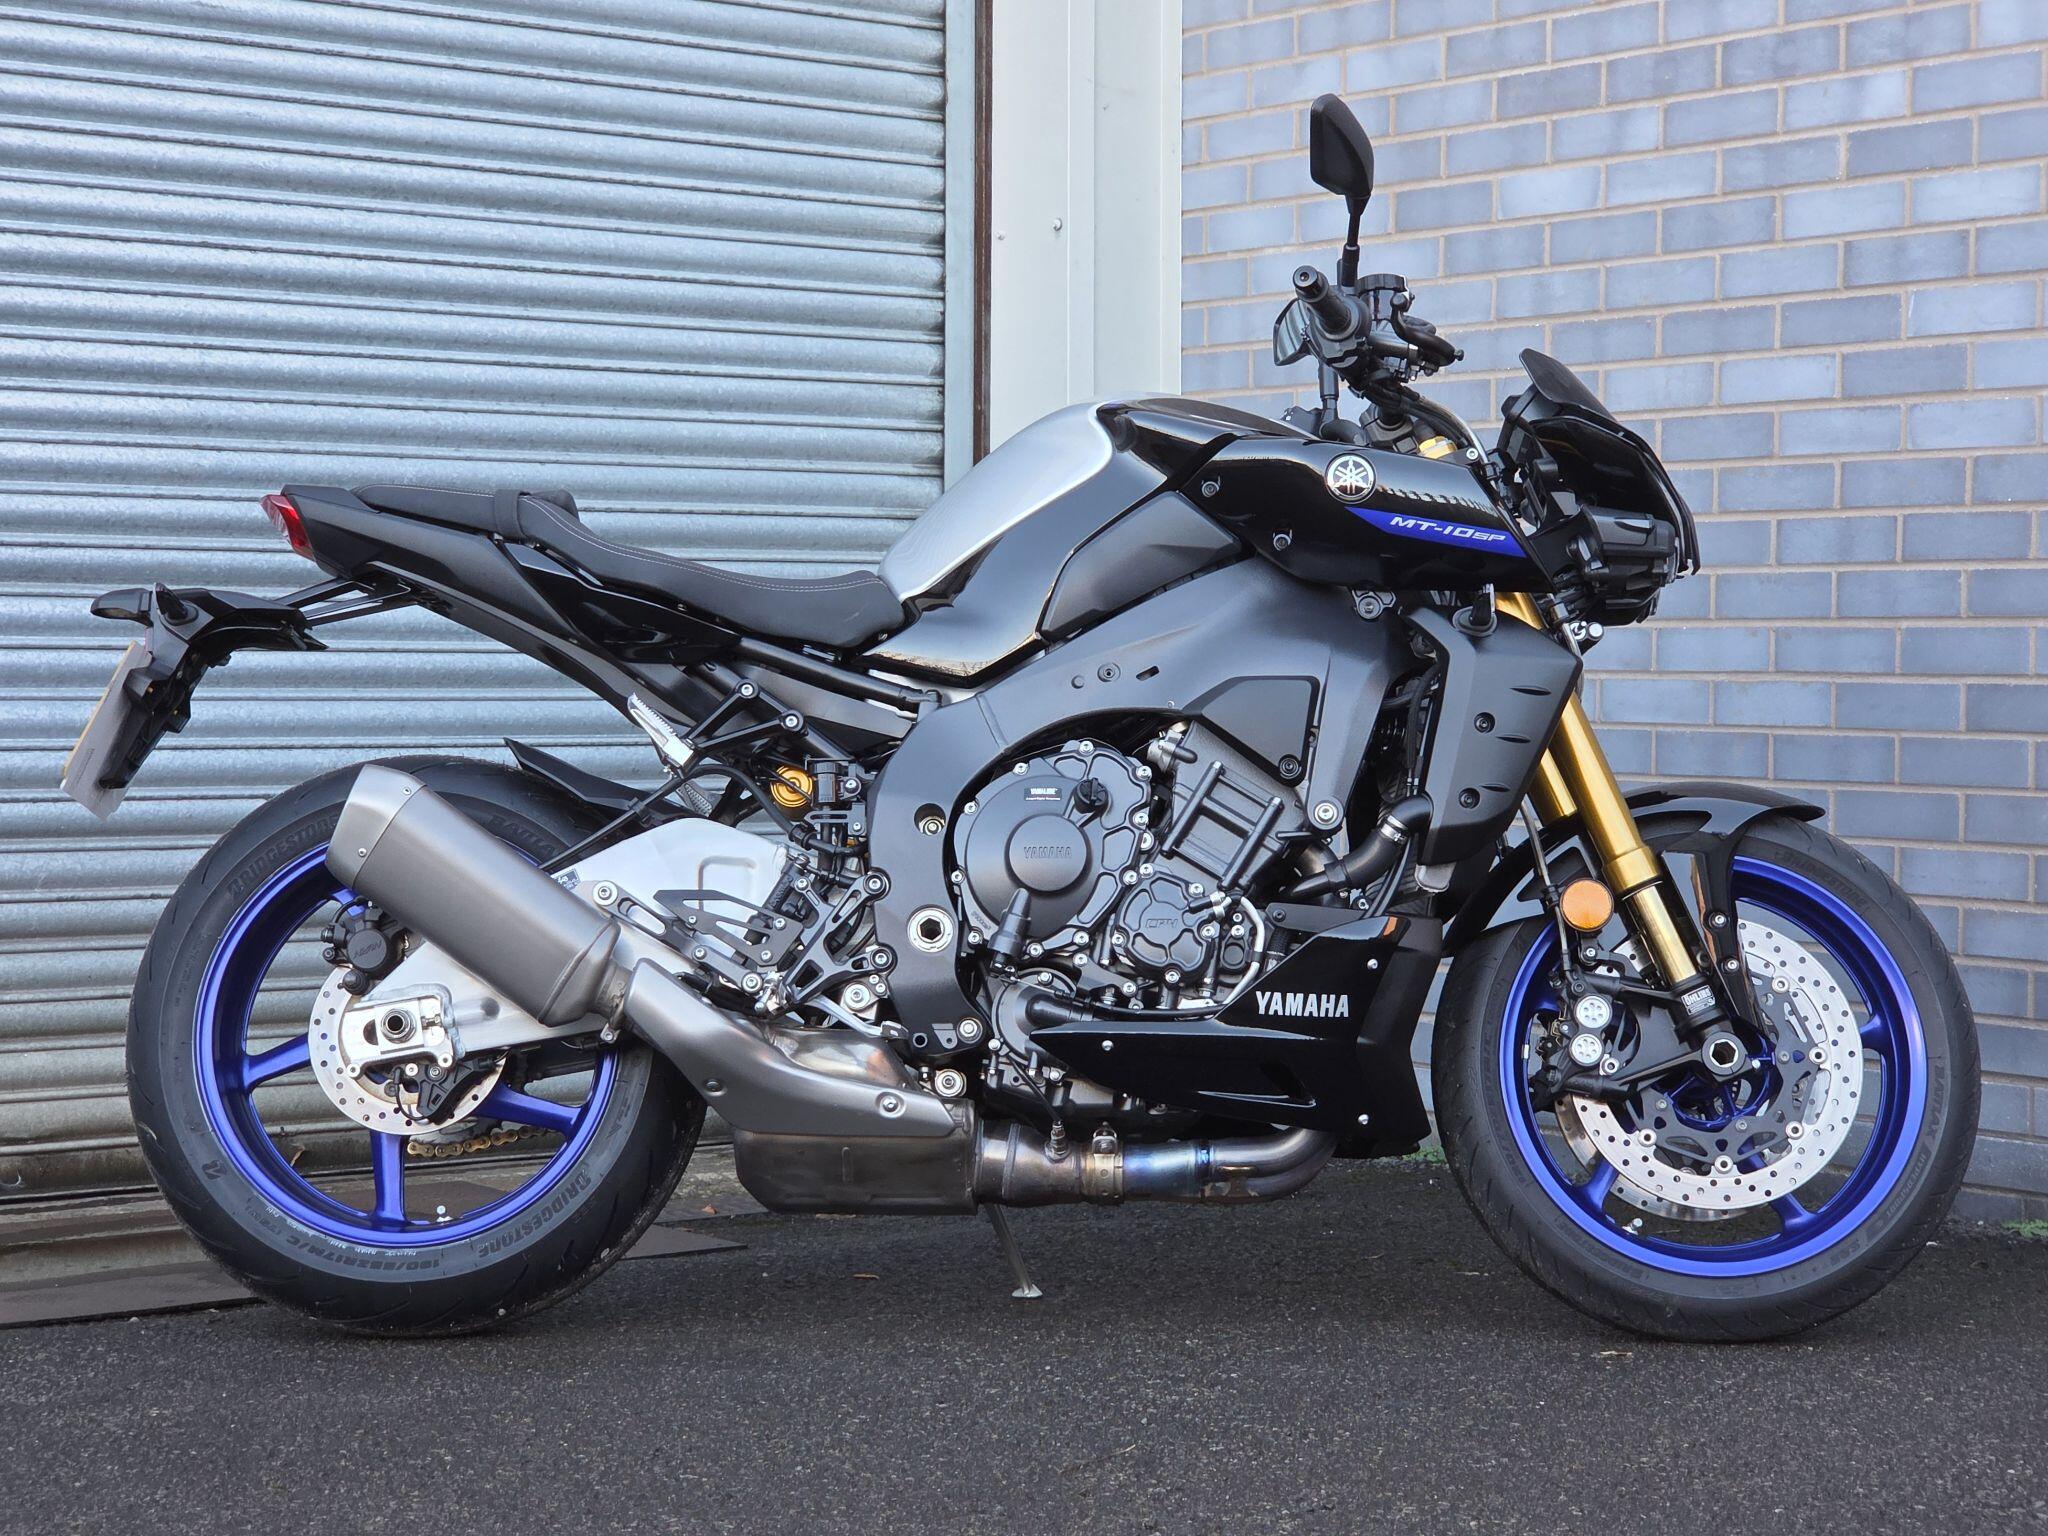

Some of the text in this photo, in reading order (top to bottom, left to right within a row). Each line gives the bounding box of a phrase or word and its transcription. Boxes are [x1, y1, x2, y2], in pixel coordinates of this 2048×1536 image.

[1023, 845, 1072, 859] YAMAHA
[1255, 990, 1350, 1018] YAMAHA
[478, 1169, 592, 1258] BRIDGESTONE
